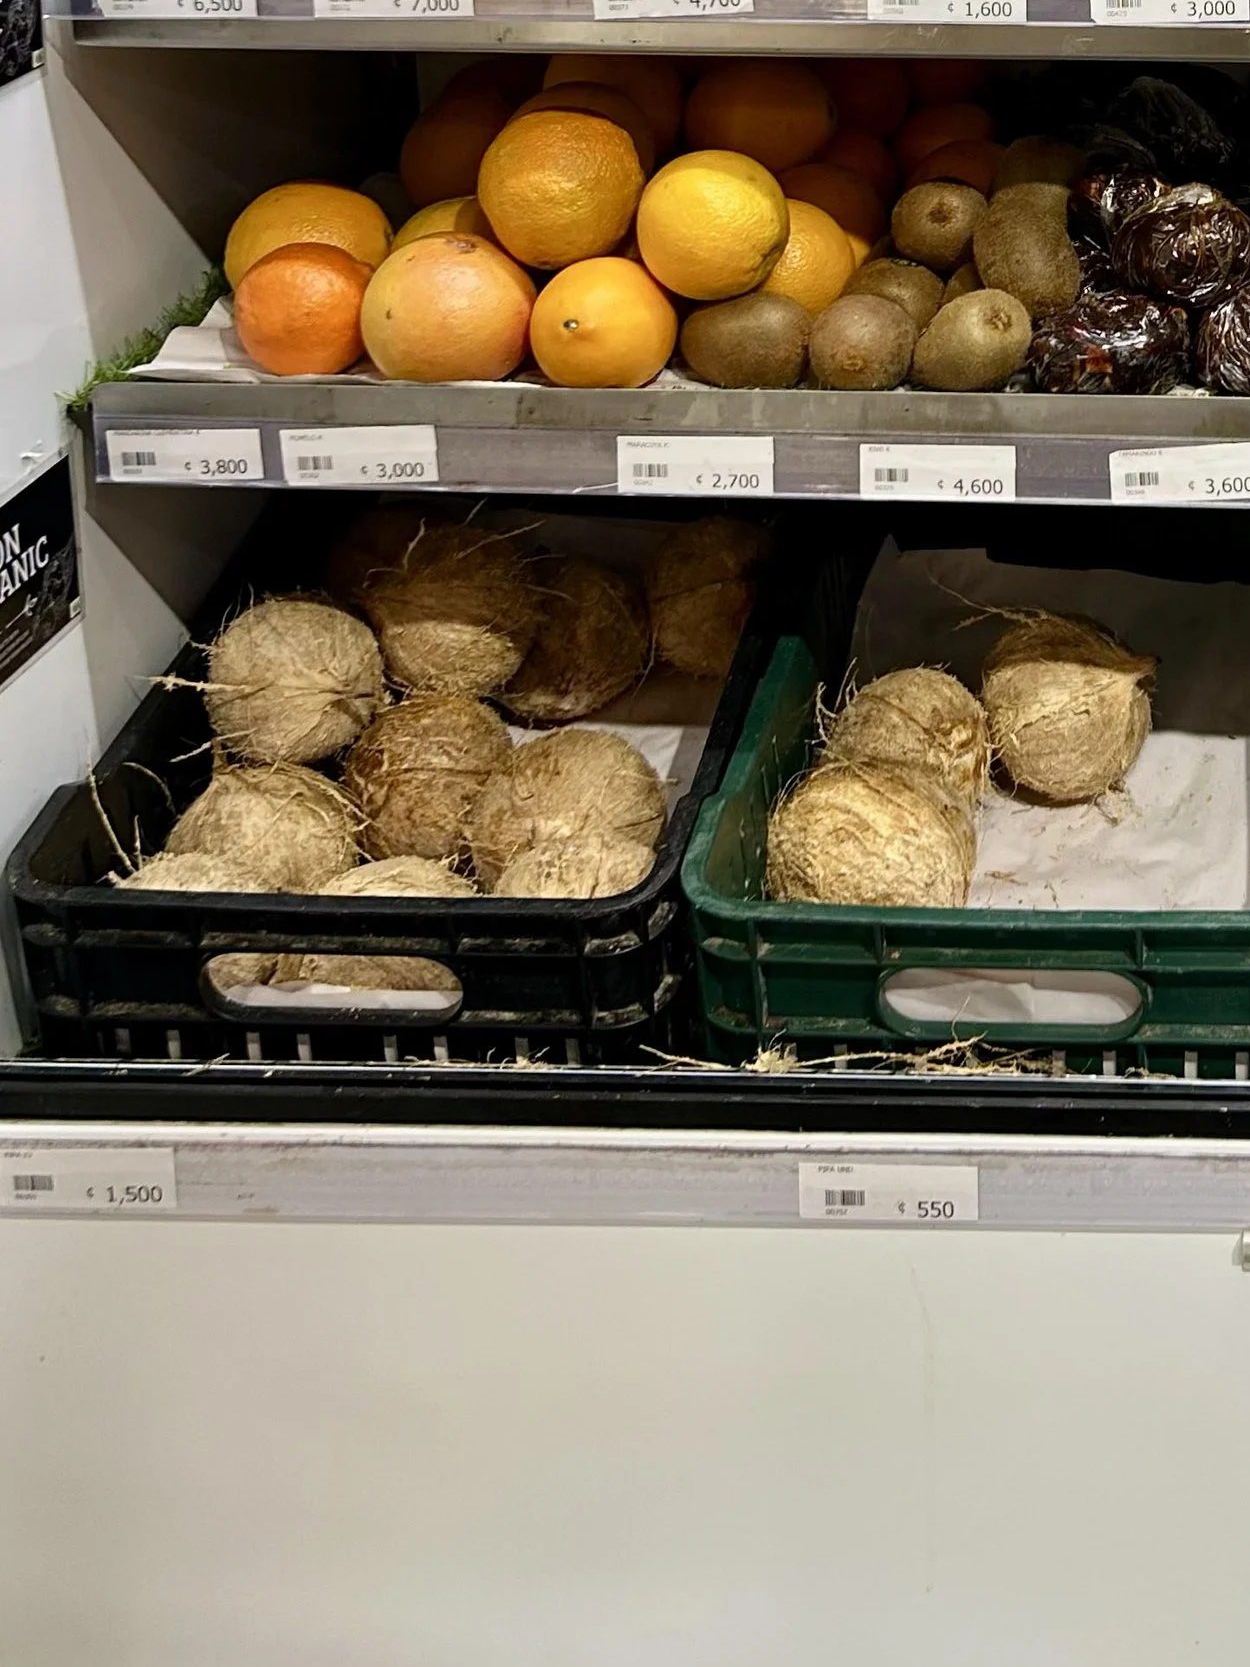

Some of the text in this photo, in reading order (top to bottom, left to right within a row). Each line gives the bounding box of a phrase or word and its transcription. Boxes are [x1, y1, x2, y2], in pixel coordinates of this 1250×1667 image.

[966, 2, 1012, 19] 1,600
[1188, 1, 1235, 18] 3,000
[201, 459, 247, 476] 3,800
[376, 463, 426, 482] 3,000
[713, 474, 759, 489] 2,700
[954, 479, 1003, 495] 4,600
[107, 1186, 162, 1204] 1,500
[918, 1201, 954, 1218] 550
